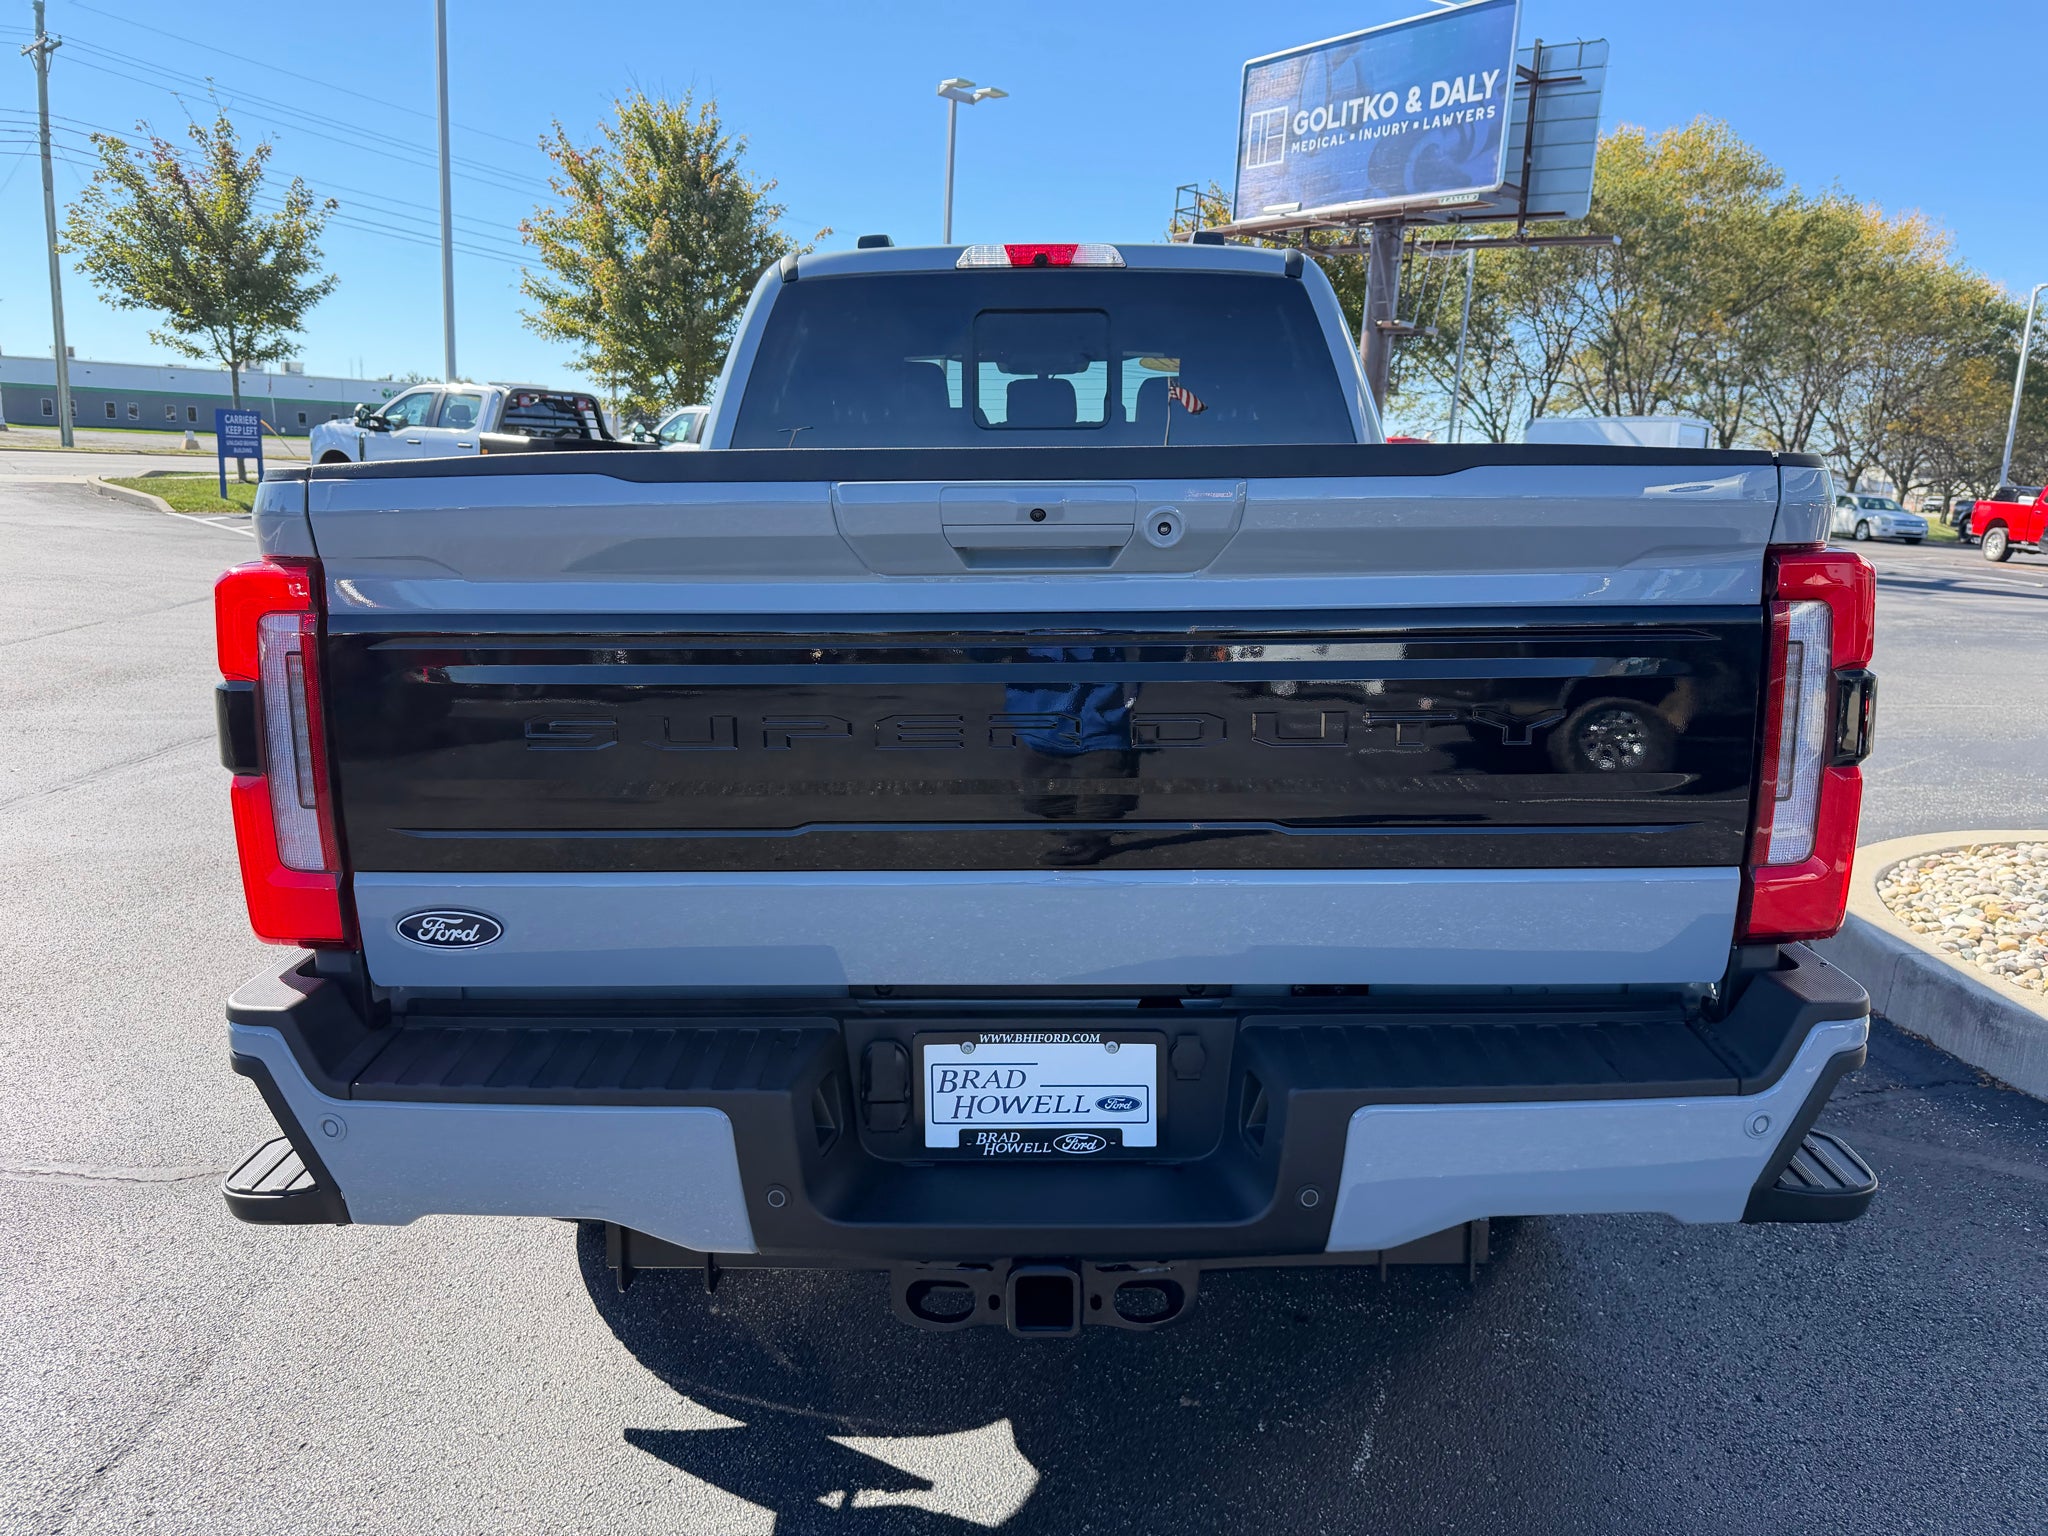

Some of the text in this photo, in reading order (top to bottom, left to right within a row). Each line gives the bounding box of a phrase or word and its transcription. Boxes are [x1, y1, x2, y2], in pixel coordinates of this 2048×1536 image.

[1292, 68, 1500, 136] GOLITKO & DALY
[1290, 104, 1496, 154] MEDICAL INJURY LAWYERS
[224, 414, 258, 425] CARRIERS
[225, 425, 258, 436] KEEP LEFT
[525, 708, 1567, 751] SUPER DUTY
[417, 916, 481, 942] Ford
[979, 1033, 1101, 1044] WWW.BHIFORD.COM
[936, 1069, 1027, 1094] BRAD
[950, 1095, 1091, 1120] HOWELL
[975, 1132, 1021, 1145] BRAD
[983, 1142, 1052, 1156] HOWELL
[1061, 1133, 1097, 1151] Ford
